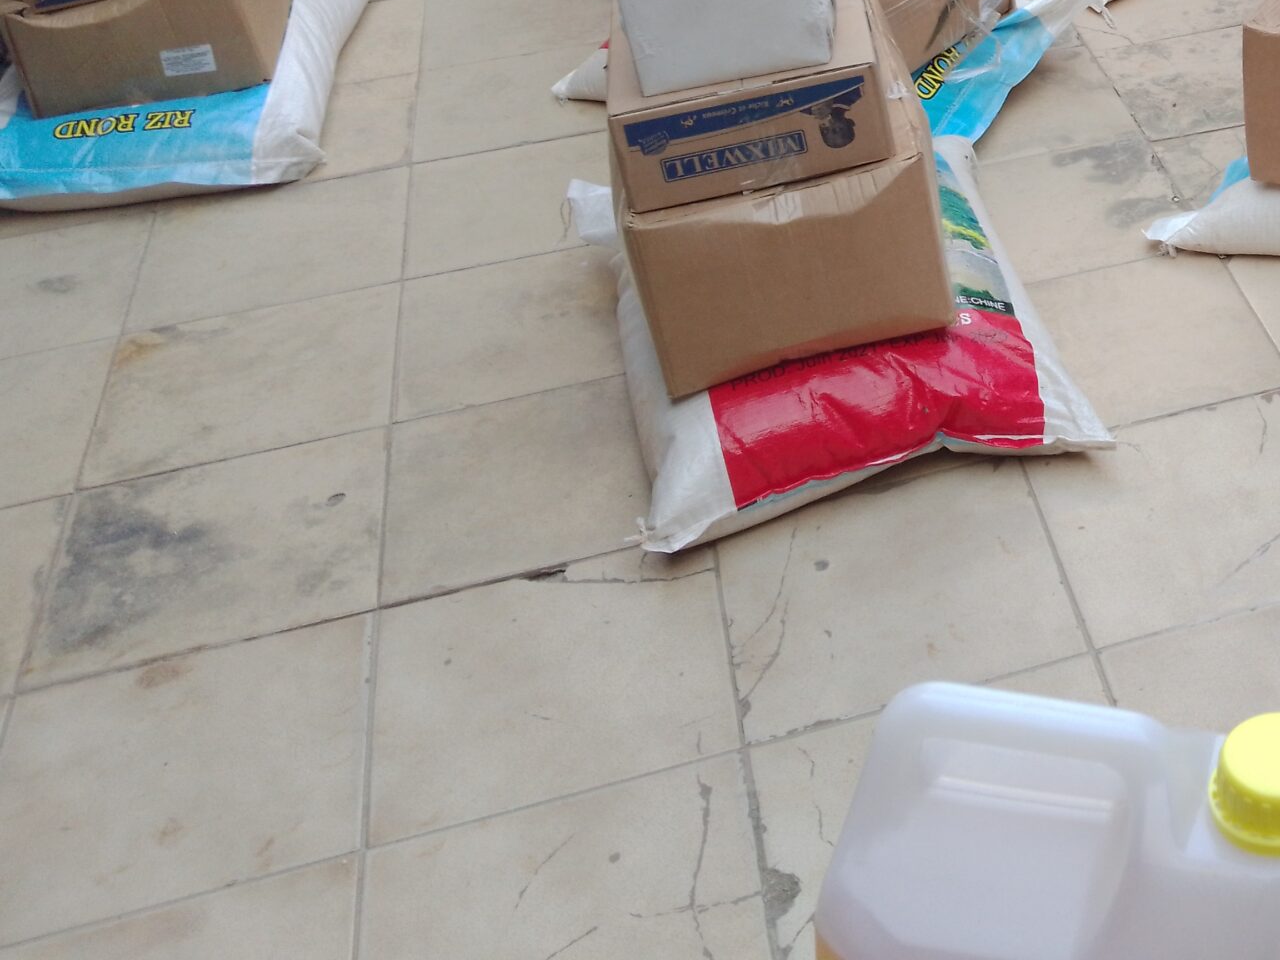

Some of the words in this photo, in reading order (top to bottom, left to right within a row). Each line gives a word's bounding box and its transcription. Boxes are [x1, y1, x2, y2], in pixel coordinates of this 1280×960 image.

[53, 113, 139, 139] ROND
[144, 109, 195, 131] RIZ
[666, 134, 801, 177] MIXWELL
